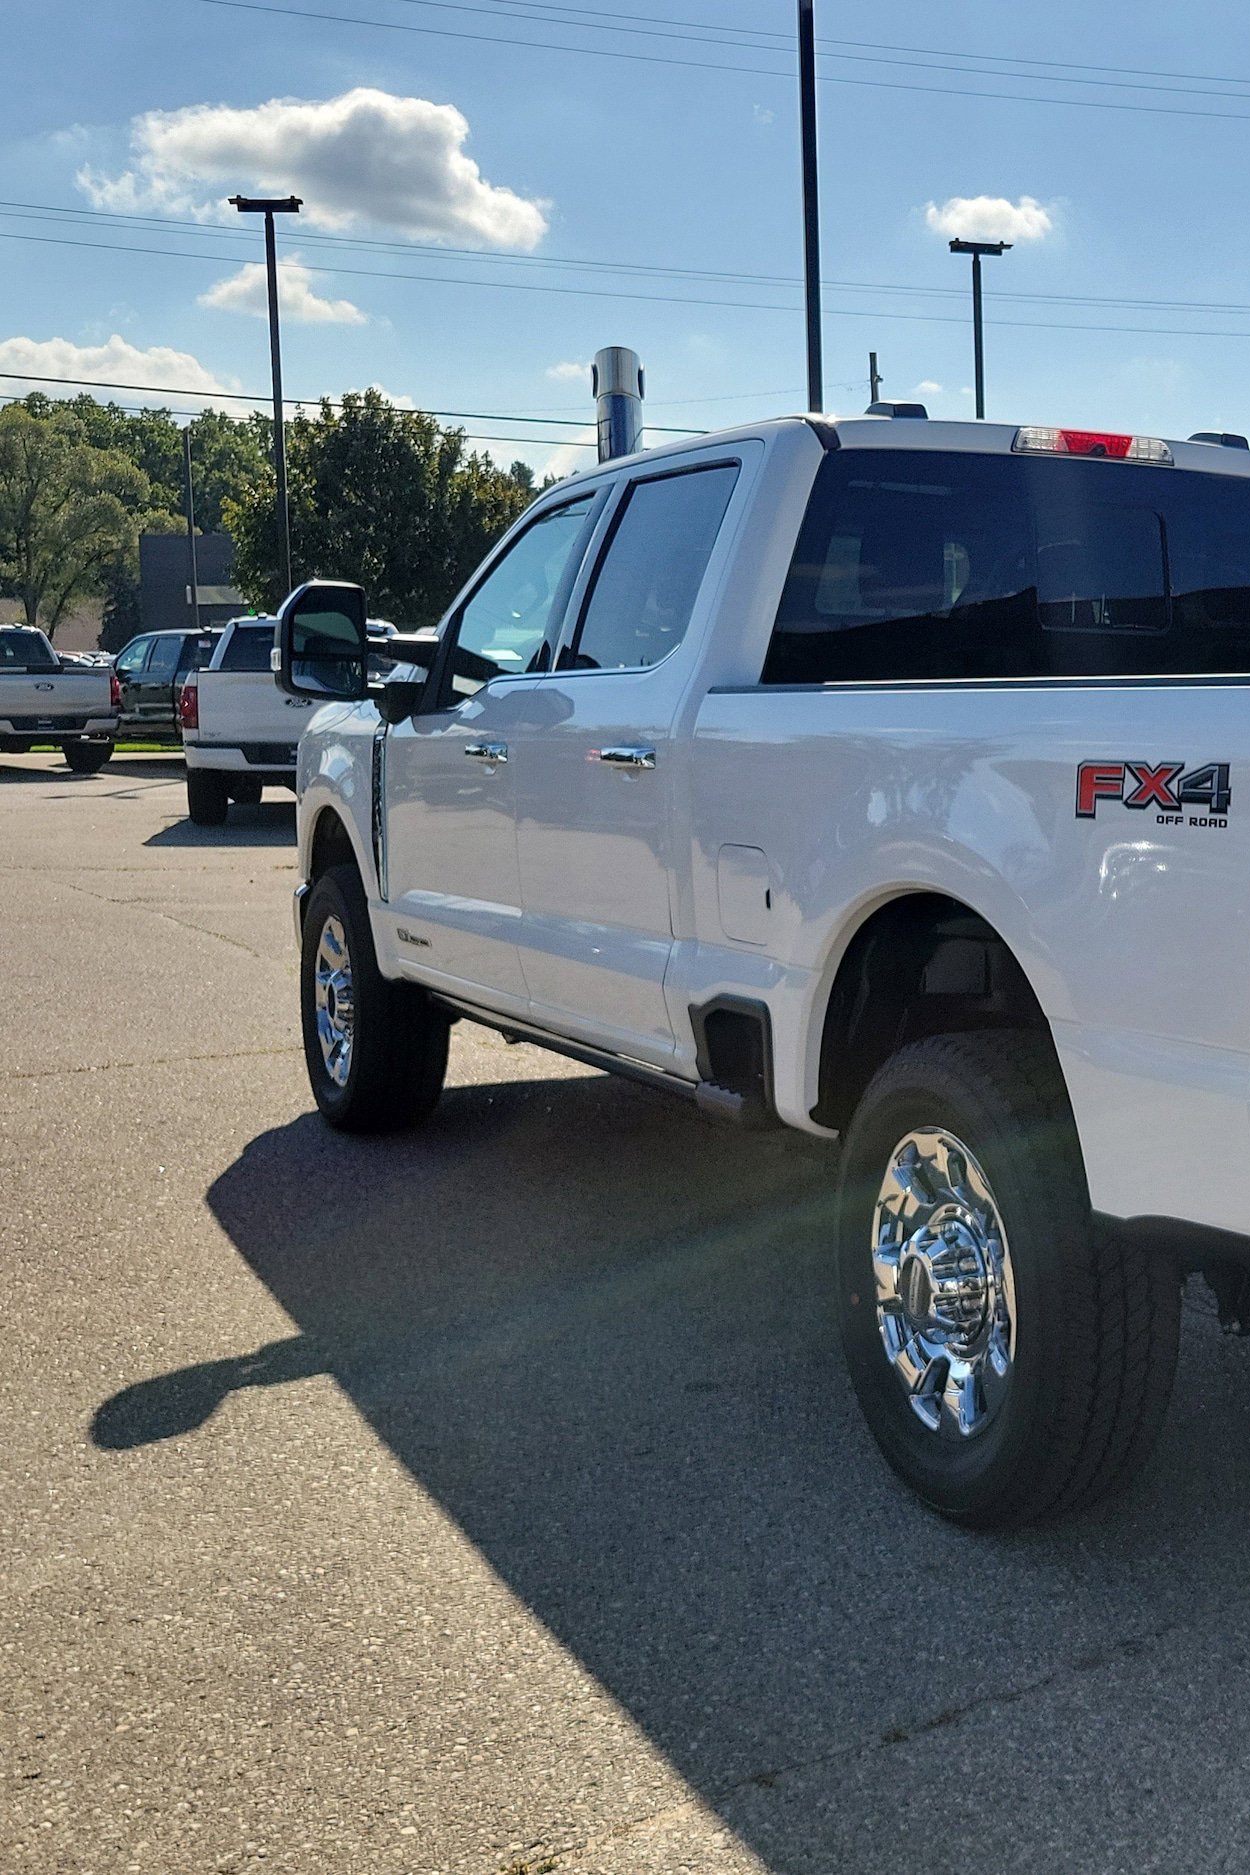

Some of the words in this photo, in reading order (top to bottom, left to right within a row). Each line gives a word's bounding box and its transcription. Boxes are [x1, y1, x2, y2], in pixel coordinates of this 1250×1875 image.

[1075, 760, 1232, 820] FX4
[1156, 815, 1184, 826] OFF
[1189, 817, 1228, 828] ROAD
